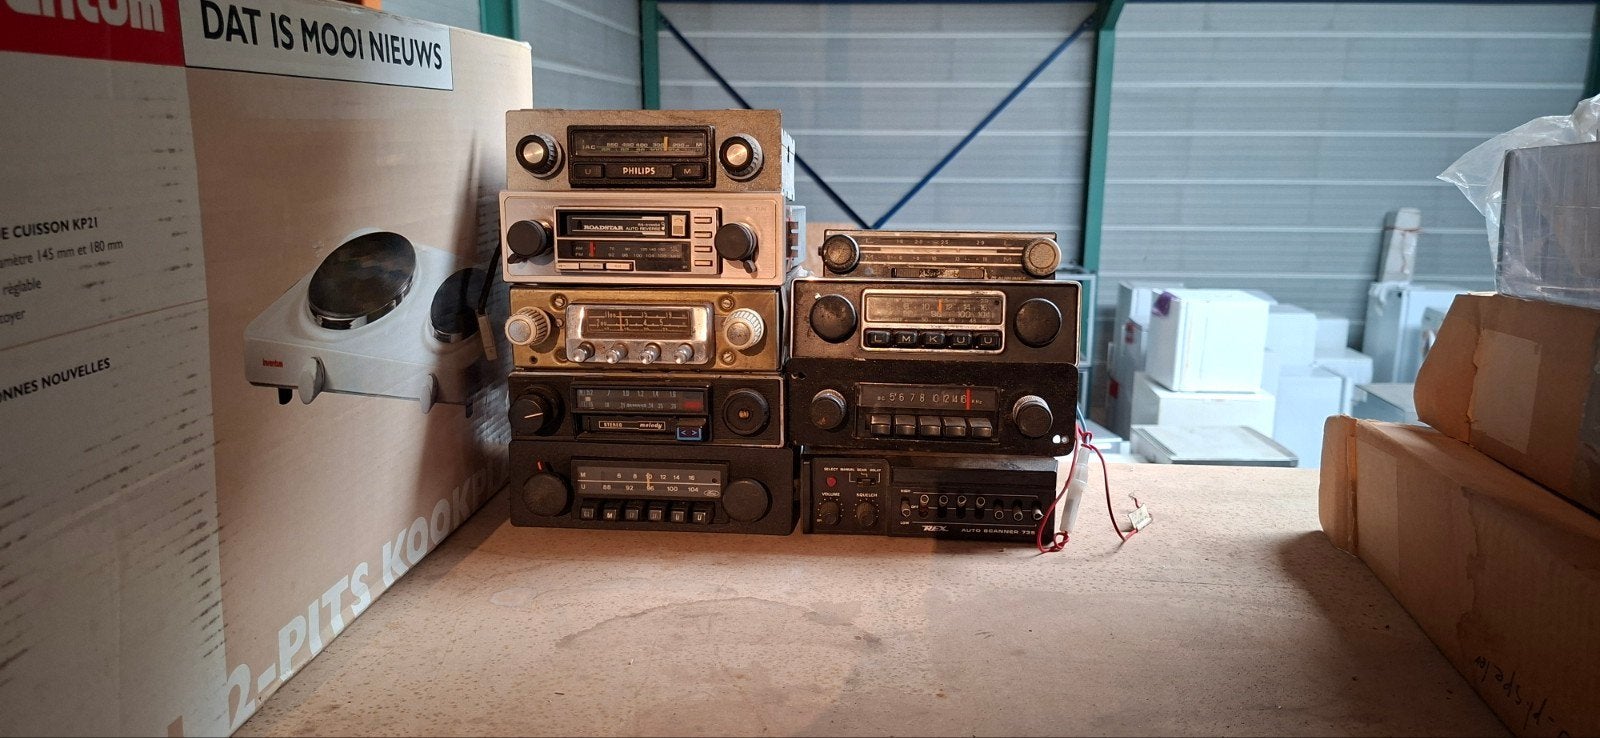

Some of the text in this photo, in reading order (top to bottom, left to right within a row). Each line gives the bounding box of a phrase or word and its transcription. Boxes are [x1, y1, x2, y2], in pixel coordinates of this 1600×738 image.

[200, 0, 443, 70] DAT IS MOOI NIEUWS
[622, 166, 656, 175] PHILIPS
[2, 216, 99, 240] E CUISSON KP21
[37, 248, 55, 261] 145
[57, 248, 75, 259] mm
[77, 245, 87, 256] et
[90, 240, 105, 254] 180
[107, 239, 123, 251] mm
[929, 335, 938, 343] K
[41, 357, 111, 389] NOUVELLES
[898, 392, 905, 402] 6
[910, 393, 915, 402] 7
[919, 393, 925, 402] 8
[639, 422, 663, 430] melody
[228, 562, 372, 730] 2-PITS
